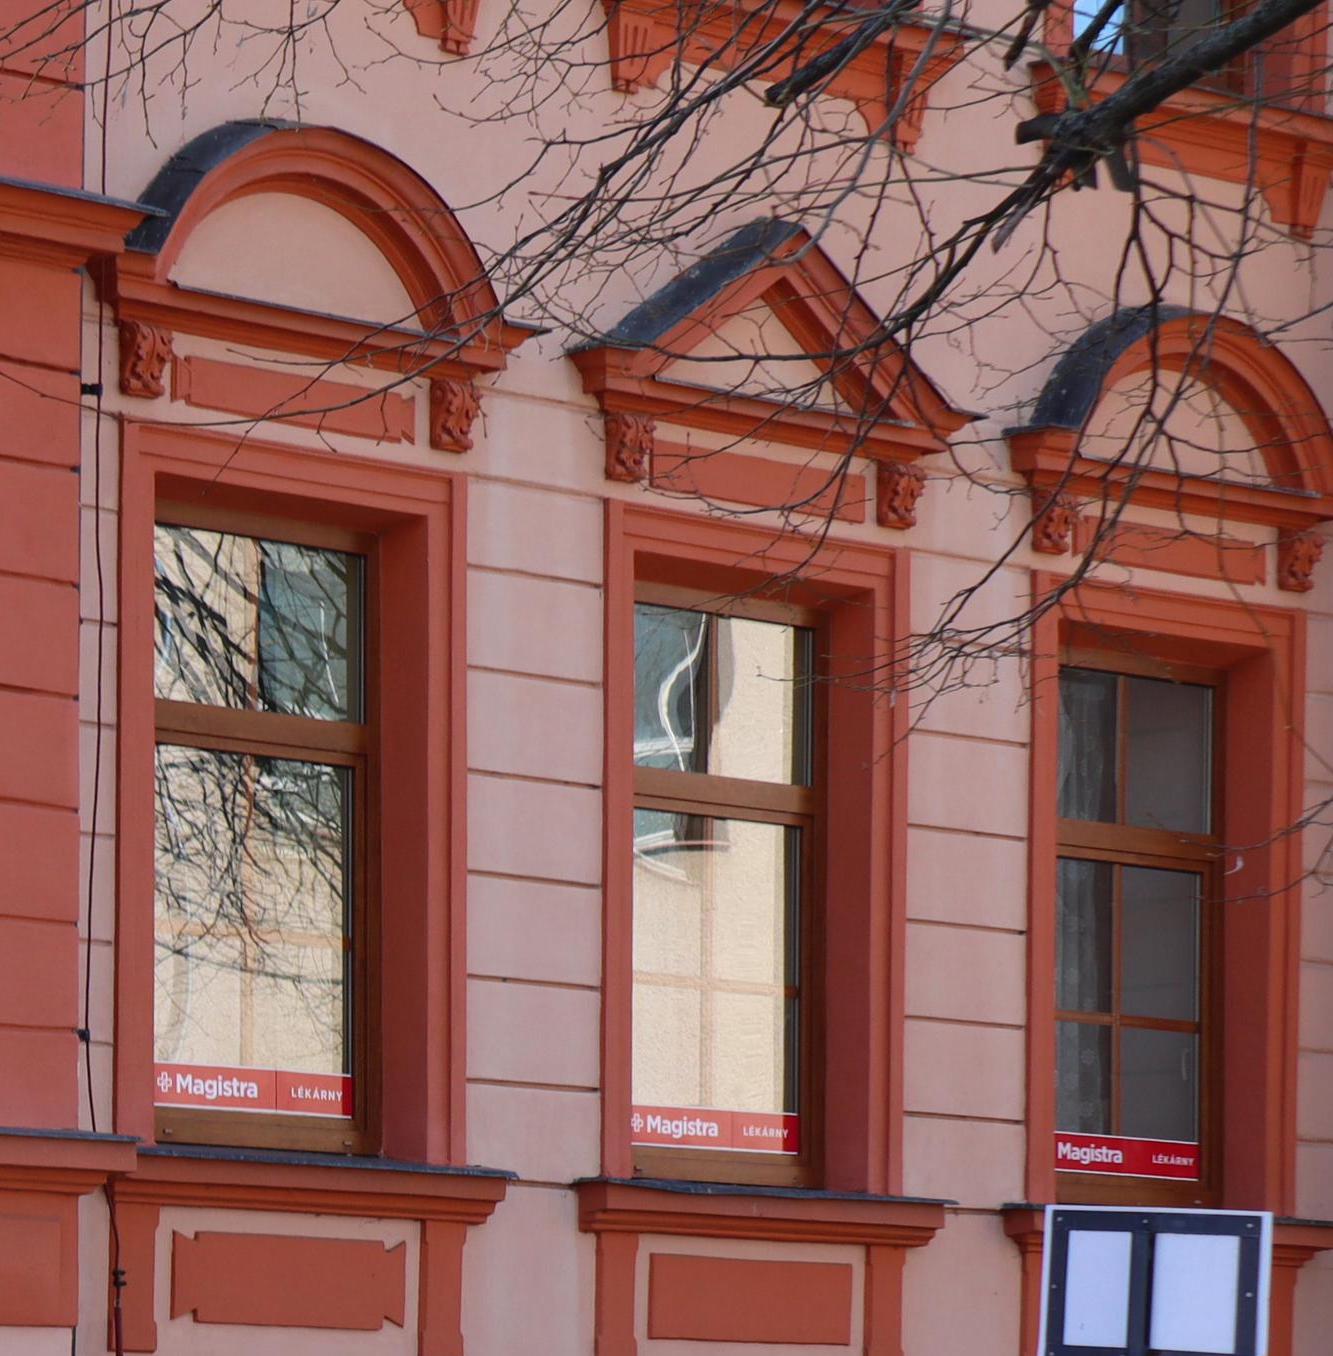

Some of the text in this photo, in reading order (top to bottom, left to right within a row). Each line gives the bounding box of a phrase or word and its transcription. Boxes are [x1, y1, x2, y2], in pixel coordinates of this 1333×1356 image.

[175, 1073, 343, 1102] Magistra LÉKÁRNY
[646, 1114, 789, 1139] Magistra LÉKÁRNY
[1056, 1141, 1195, 1167] Magistra LÉKÁRNY
